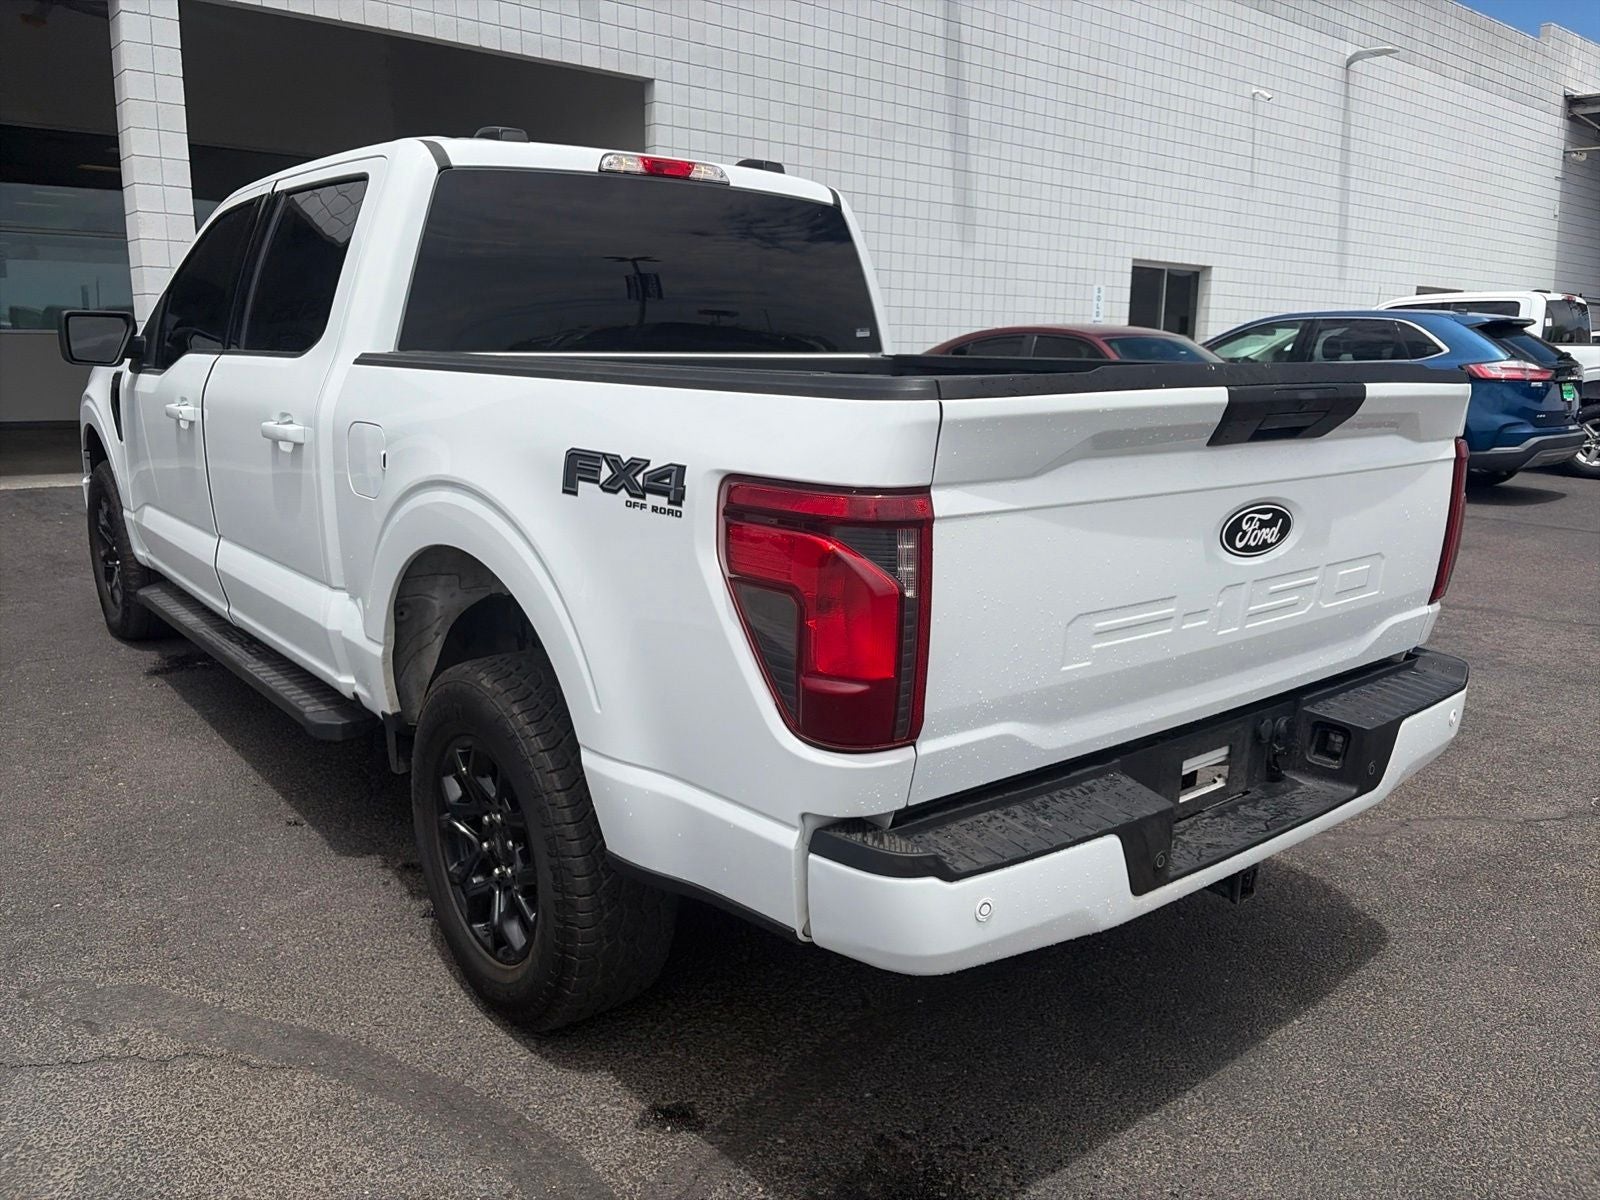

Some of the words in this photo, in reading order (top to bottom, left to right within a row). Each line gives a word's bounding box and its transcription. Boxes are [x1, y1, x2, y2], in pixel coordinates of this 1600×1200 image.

[561, 447, 687, 508] FX4
[625, 500, 647, 511] OFF
[651, 505, 683, 518] ROAD
[1235, 512, 1283, 549] Ford
[1060, 551, 1386, 671] F-150
